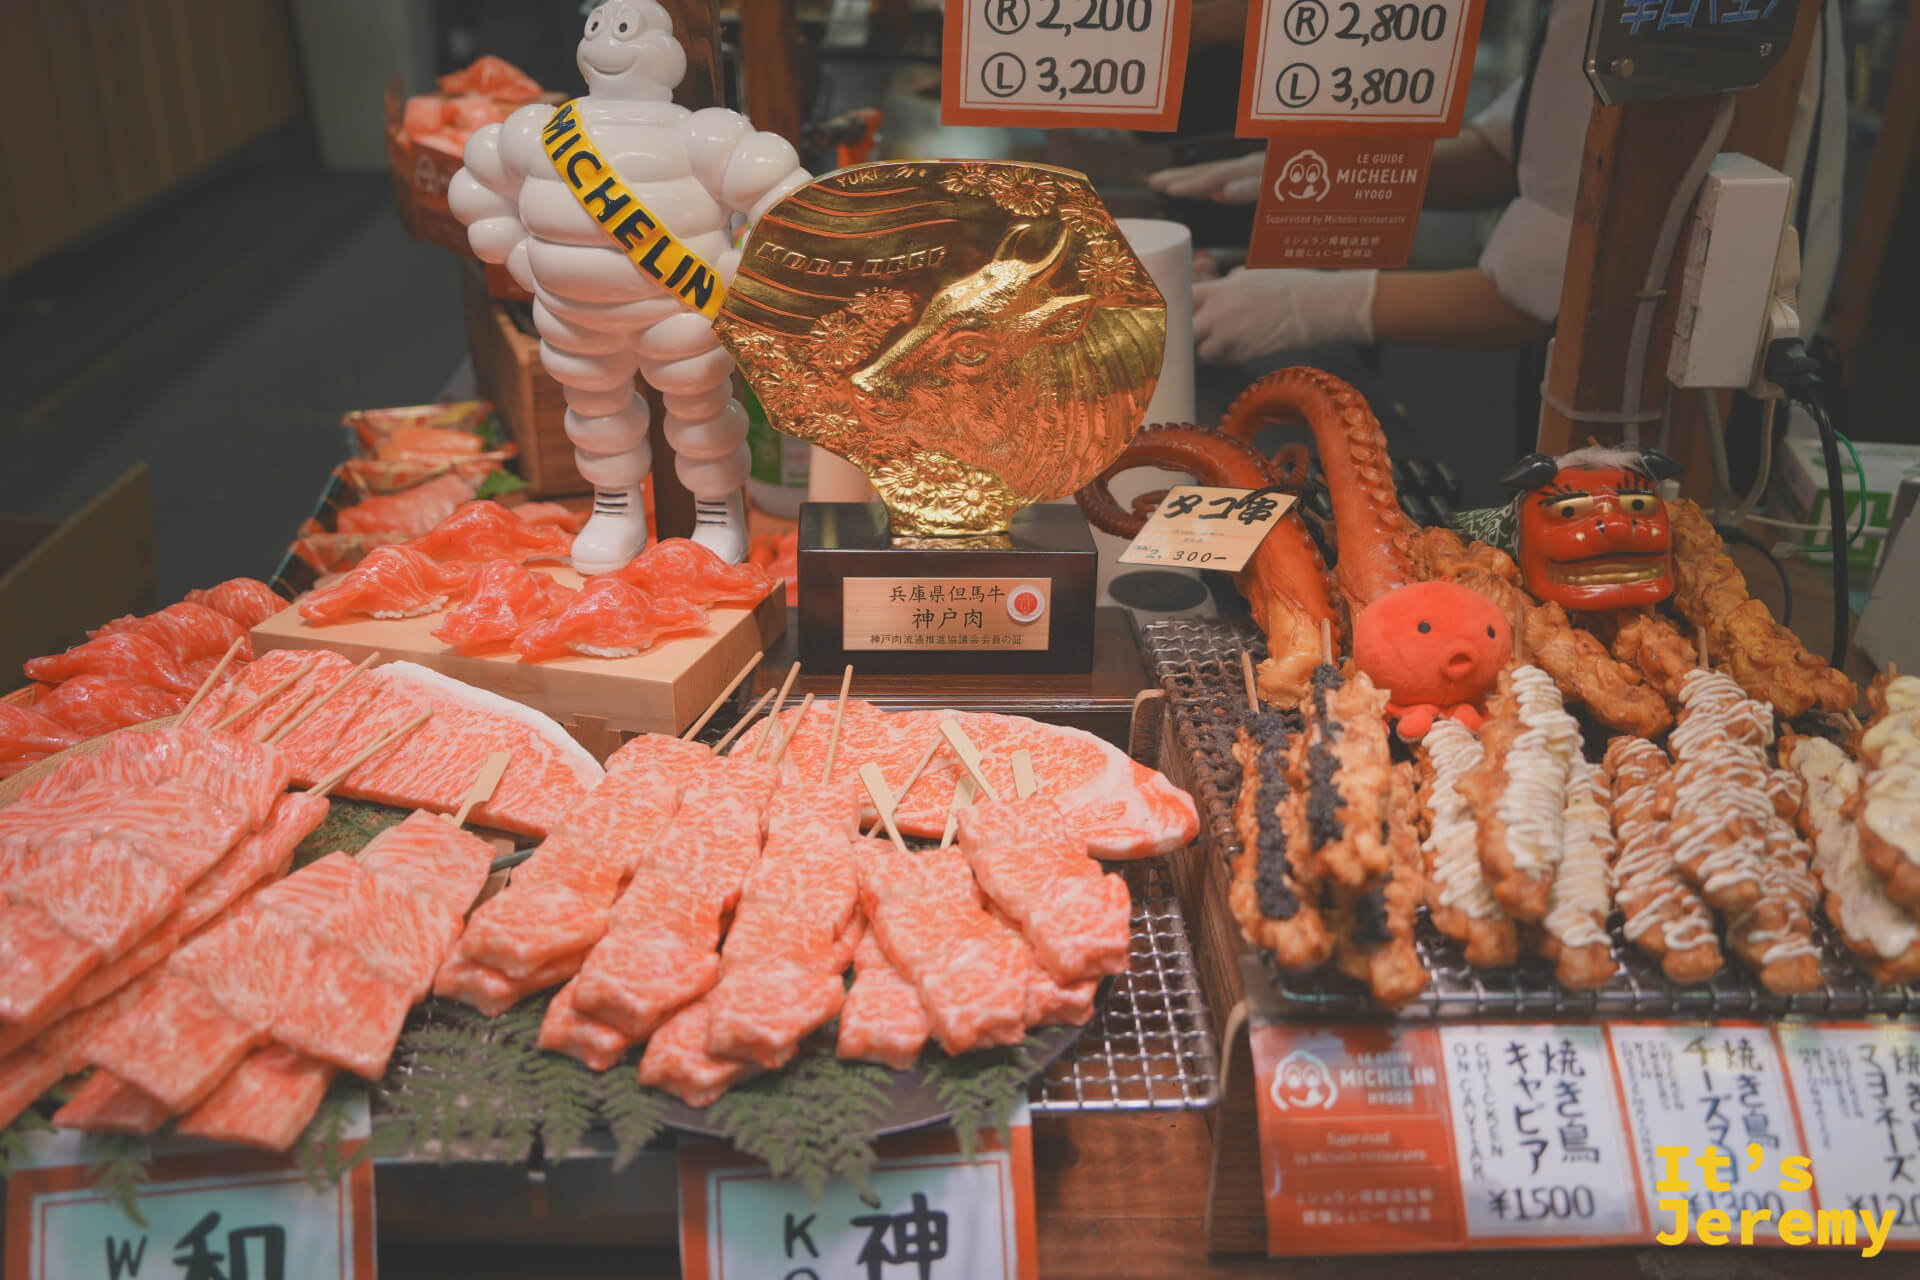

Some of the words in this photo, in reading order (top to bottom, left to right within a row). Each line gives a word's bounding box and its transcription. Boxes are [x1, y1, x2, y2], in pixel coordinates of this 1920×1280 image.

[1035, 0, 1152, 37] 2,200
[1335, 2, 1446, 47] 2,800
[1035, 57, 1146, 100] 3,200
[1331, 67, 1435, 110] 3,800
[1336, 168, 1418, 184] MICHELIN
[1356, 153, 1371, 164] LE
[1373, 153, 1405, 164] GUIDE
[543, 103, 715, 310] MICHELIN
[1355, 189, 1393, 200] HYOGO
[755, 241, 853, 277] KOBE
[889, 584, 1005, 604] 兵庫県但馬牛
[912, 608, 984, 630] 神戸肉
[1339, 1066, 1437, 1088] MICHELIN
[1724, 1036, 1780, 1150] 焼き鳥
[1475, 1042, 1503, 1158] CHICKEN
[1505, 1041, 1549, 1176] キャビア
[1540, 1038, 1600, 1164] 焼き鳥
[1857, 1044, 1916, 1184] マヨネーズ
[1488, 1185, 1595, 1222] ¥1500
[851, 1192, 949, 1280] 神
